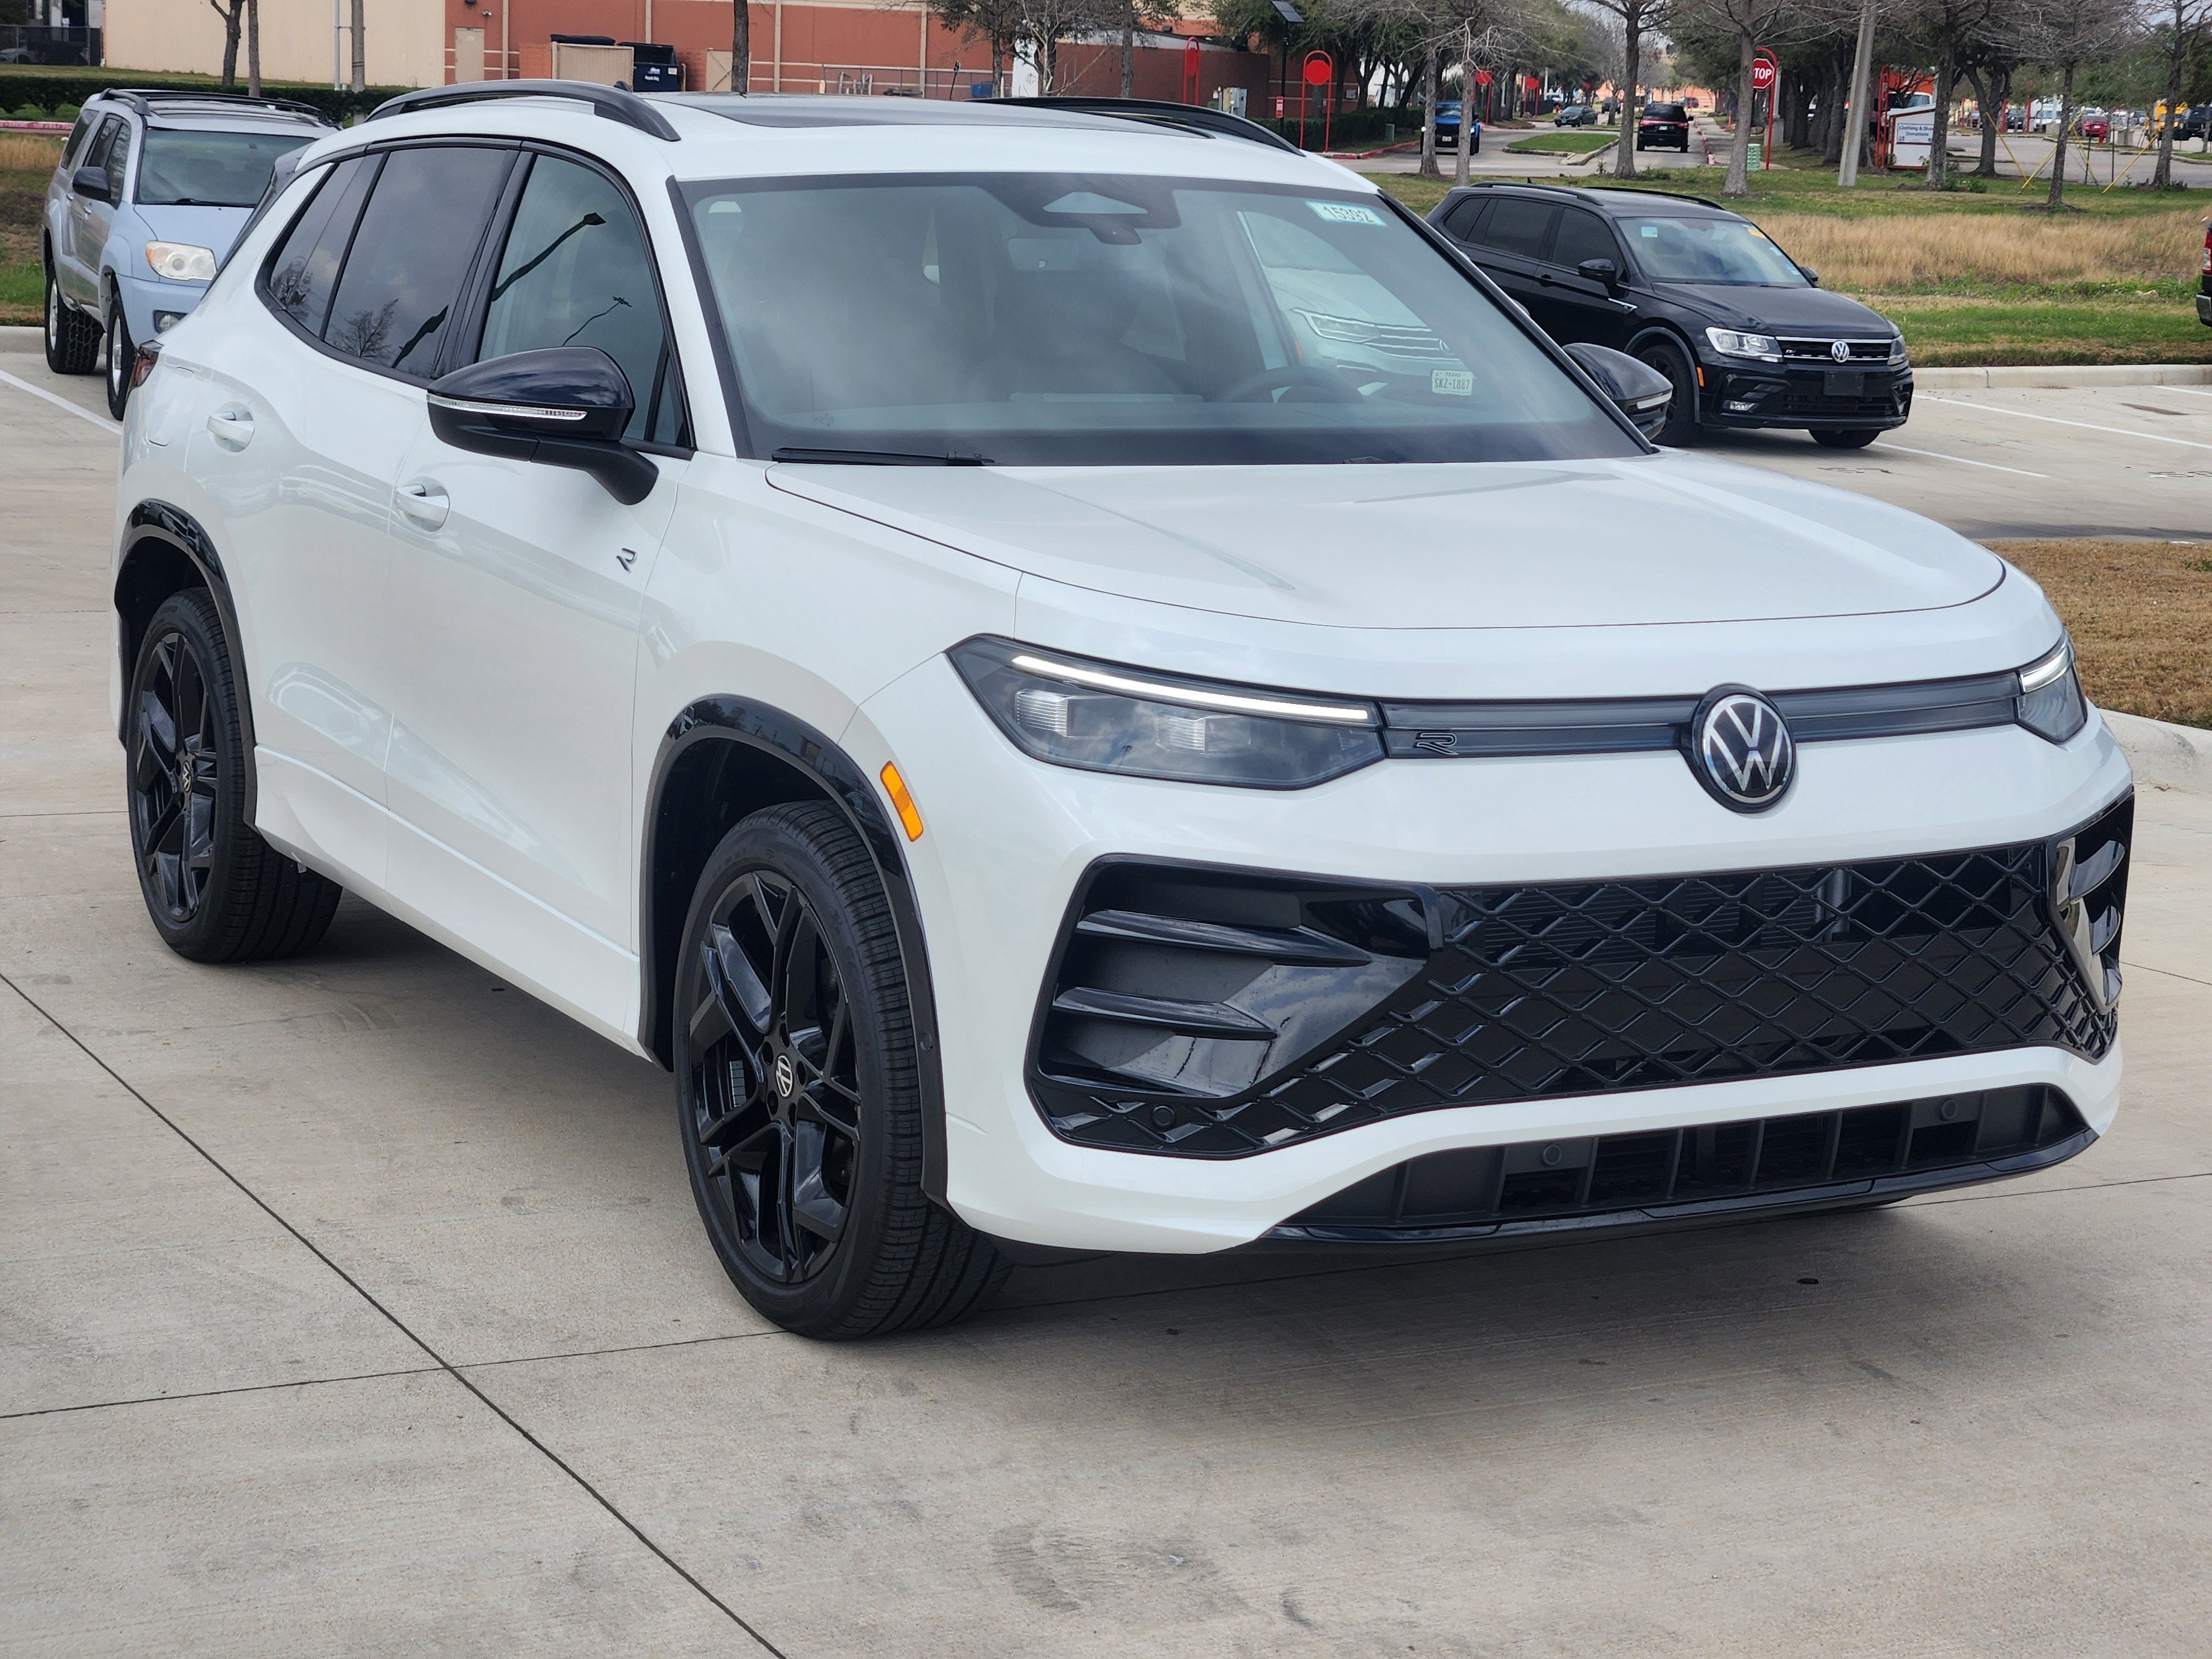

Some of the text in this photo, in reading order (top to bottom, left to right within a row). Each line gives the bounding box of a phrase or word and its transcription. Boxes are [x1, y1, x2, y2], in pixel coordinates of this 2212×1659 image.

[1754, 67, 1772, 79] TOP
[1323, 206, 1375, 222] 15392
[1415, 732, 1459, 755] R
[1705, 696, 1790, 799] VW
